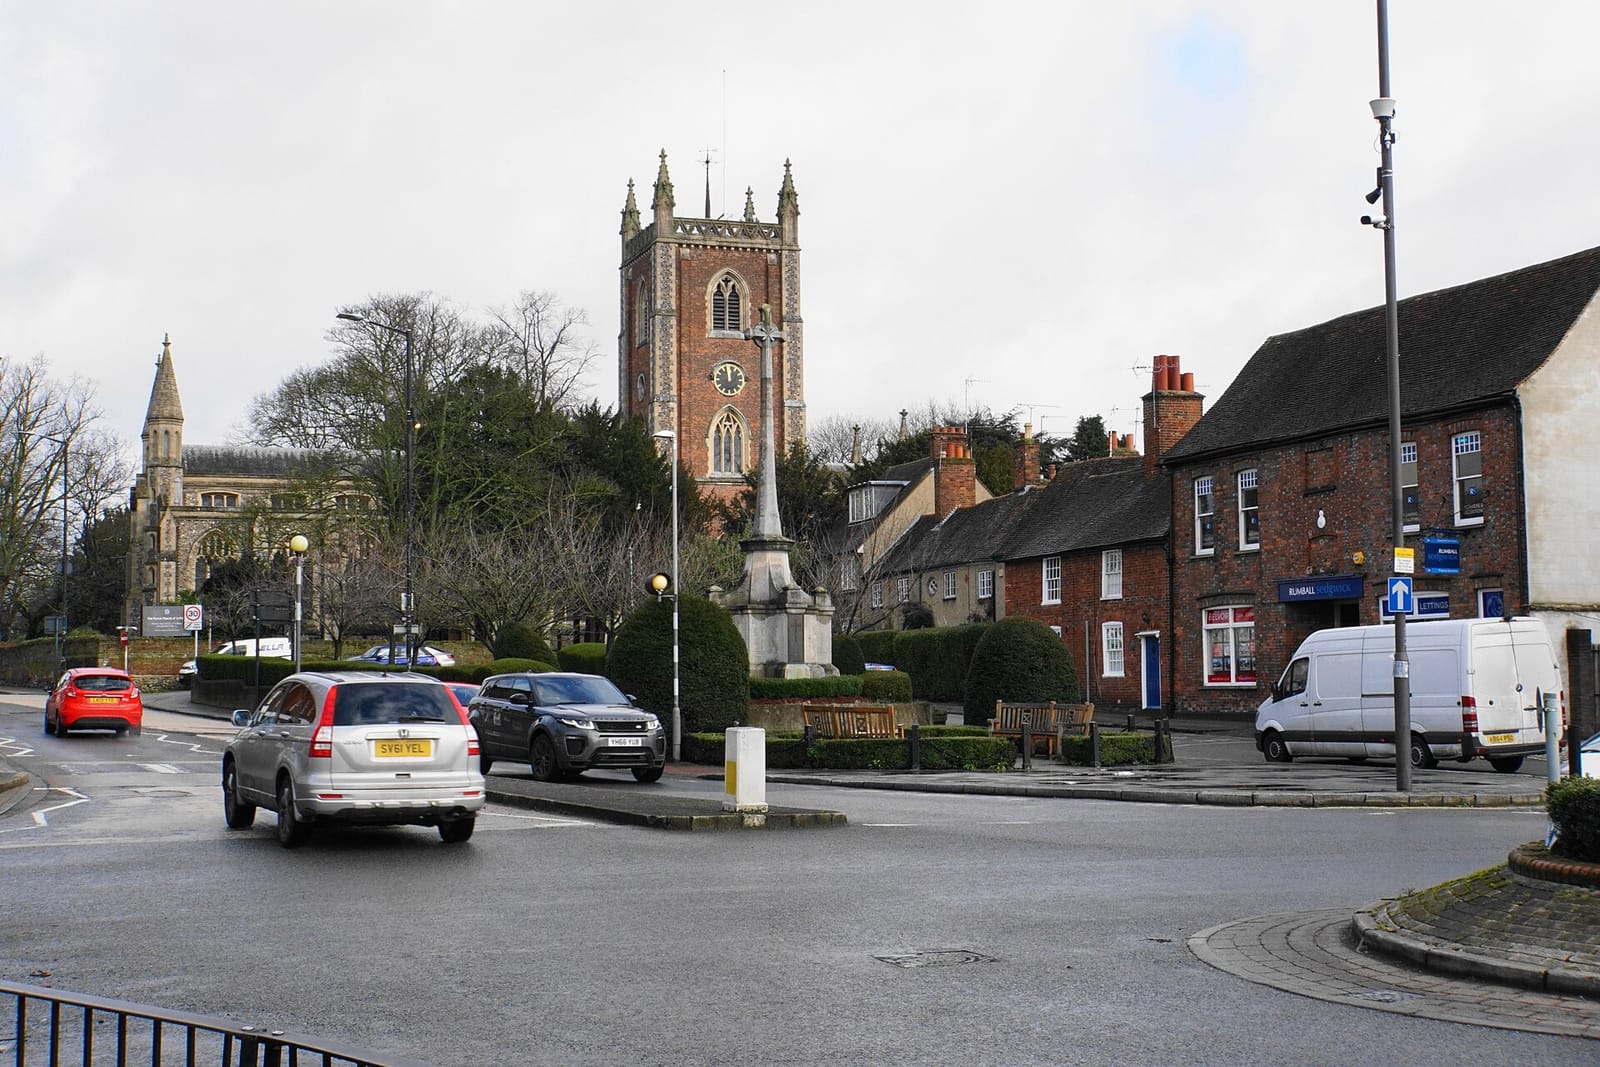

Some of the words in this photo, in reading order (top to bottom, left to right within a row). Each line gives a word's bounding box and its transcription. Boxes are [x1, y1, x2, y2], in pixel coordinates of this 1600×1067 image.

[1288, 586, 1315, 596] RUMBALL
[1316, 582, 1351, 596] sedgwick
[1419, 601, 1448, 610] LETTINGS
[381, 744, 403, 754] SV61
[405, 743, 424, 753] YEL
